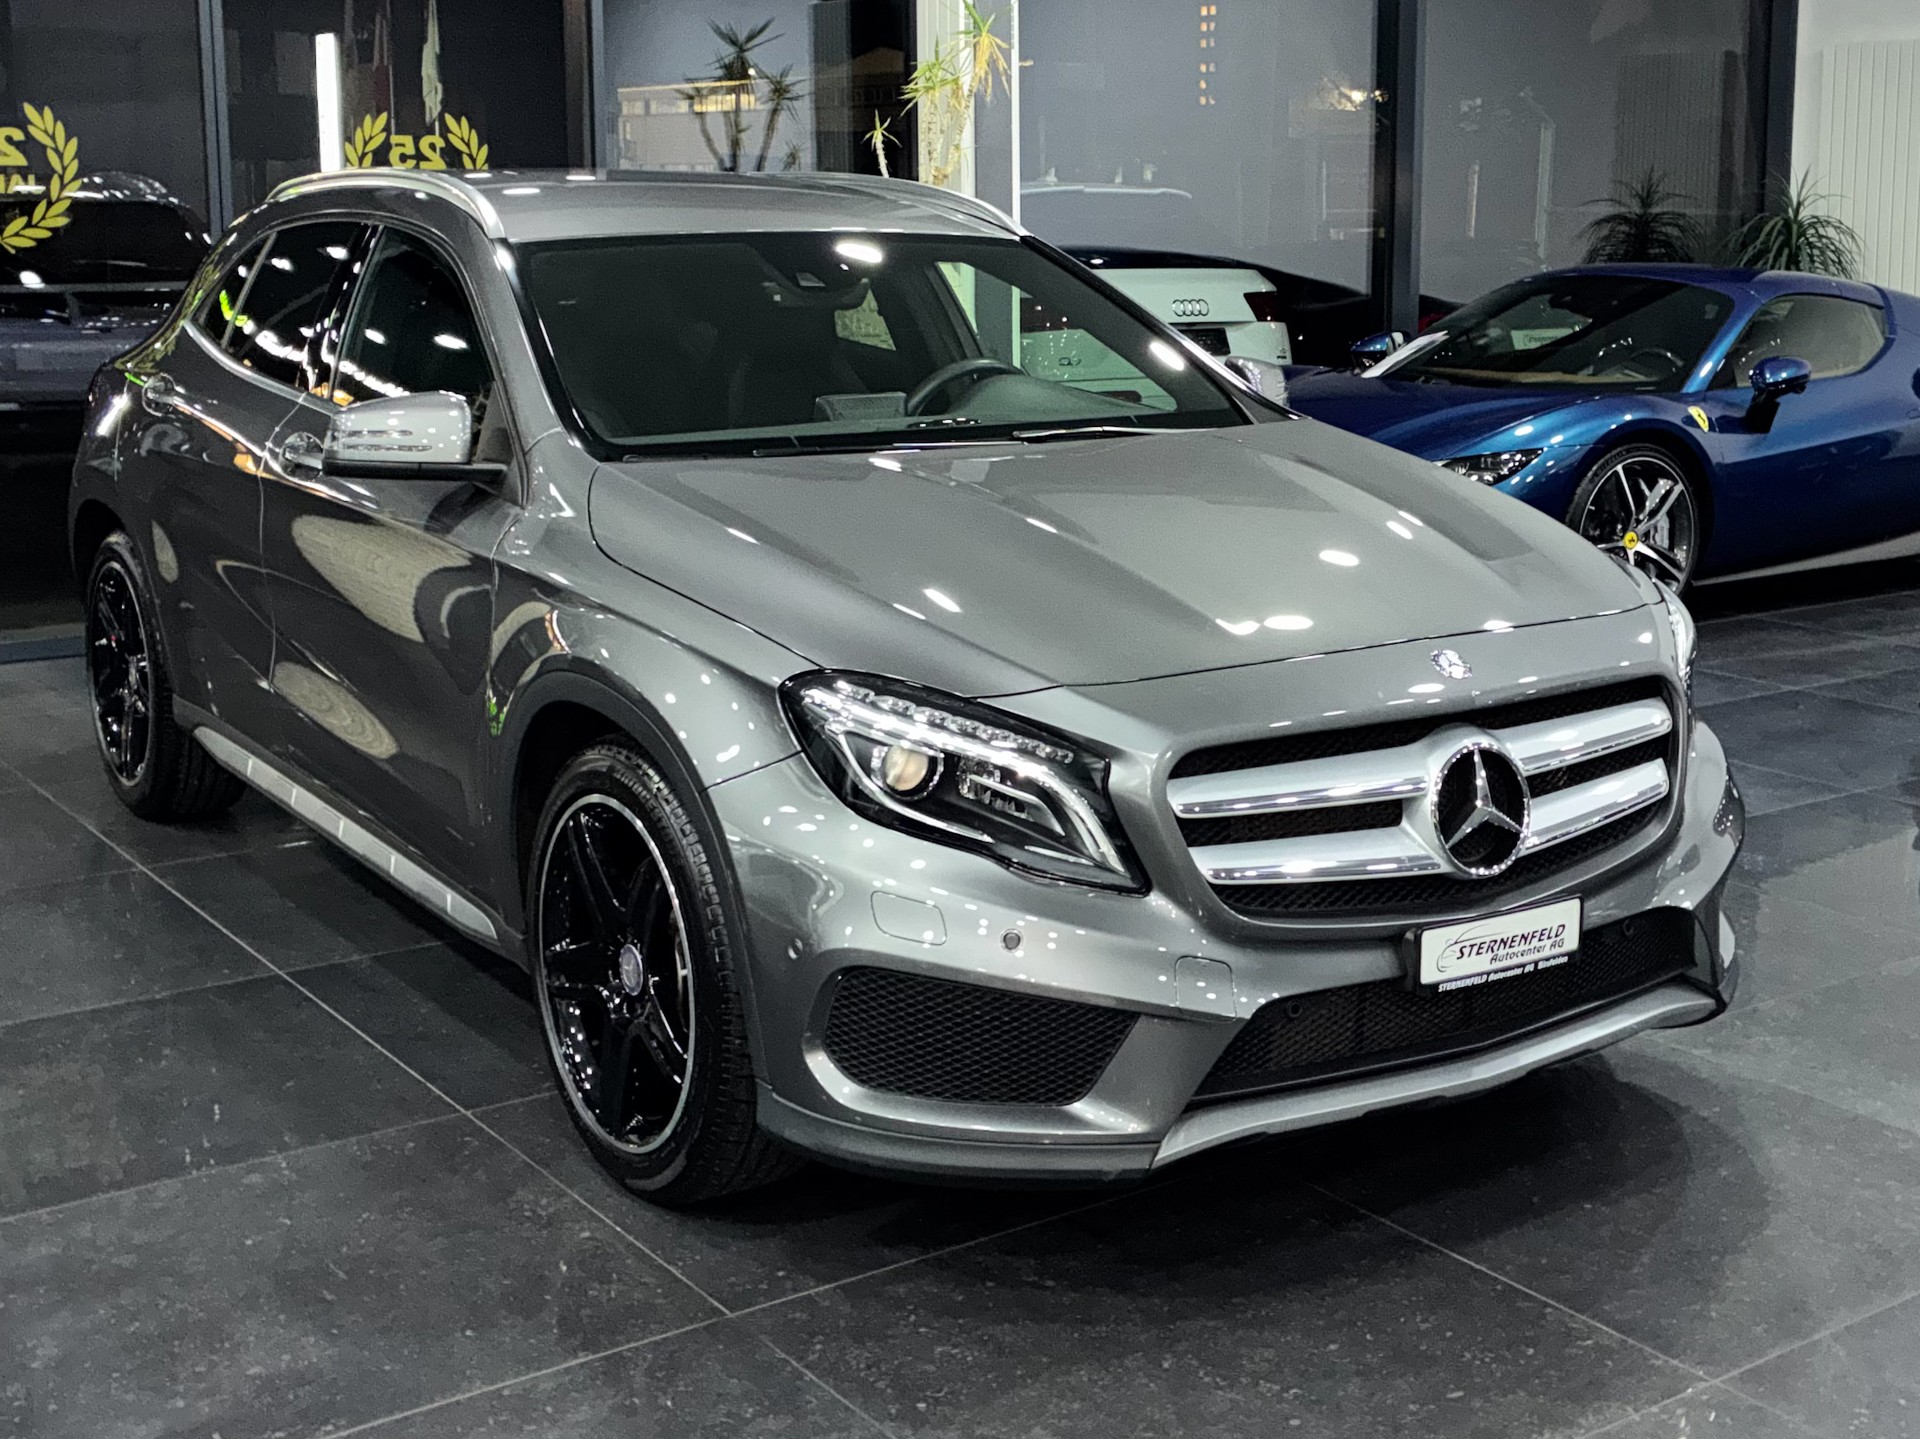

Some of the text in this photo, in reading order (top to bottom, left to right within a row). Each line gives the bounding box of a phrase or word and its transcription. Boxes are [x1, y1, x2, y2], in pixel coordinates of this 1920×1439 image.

[1457, 924, 1566, 960] STERNENFELD
[1490, 938, 1565, 965] Autocenter AG
